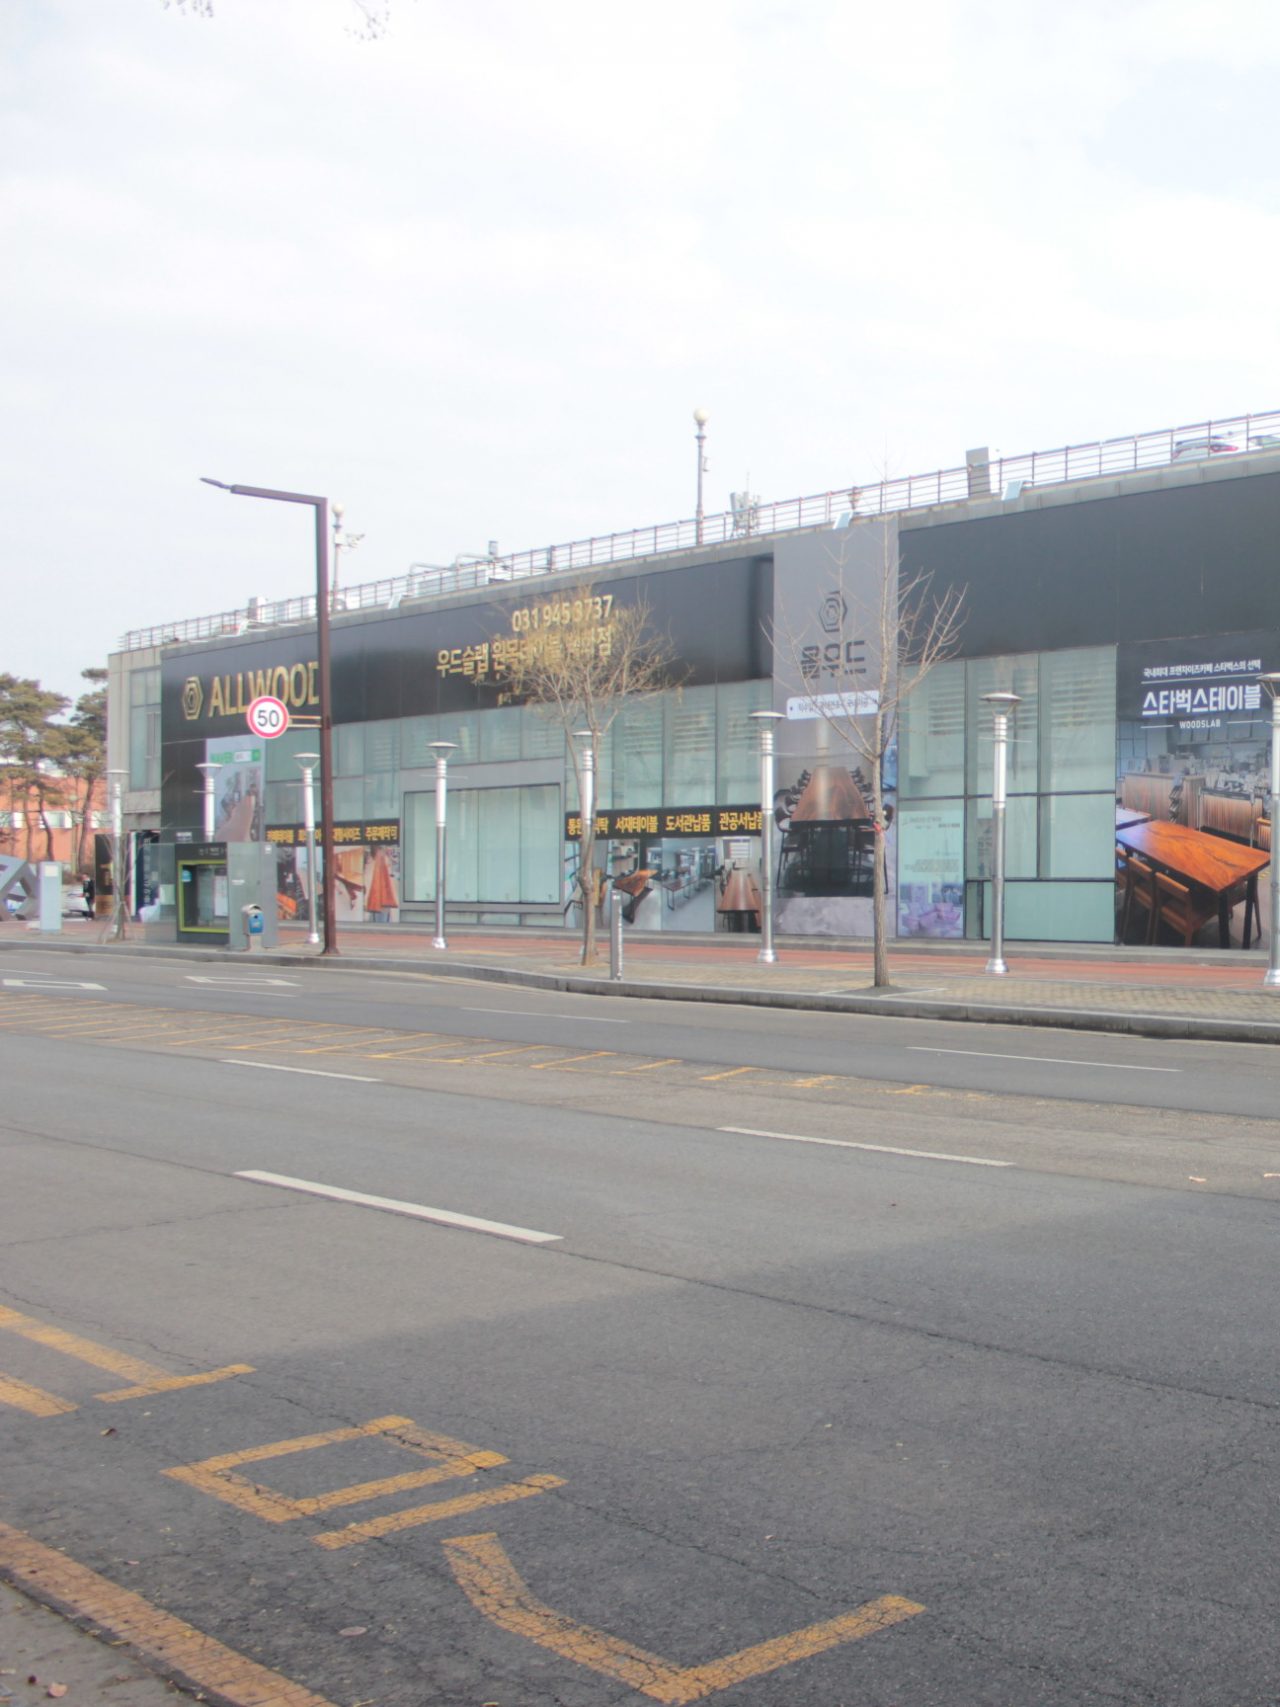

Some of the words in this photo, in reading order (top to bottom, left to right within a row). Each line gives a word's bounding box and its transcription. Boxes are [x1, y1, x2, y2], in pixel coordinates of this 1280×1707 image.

[436, 642, 489, 678] 우드슬랩
[1142, 684, 1262, 716] 스타벅스테이블
[256, 709, 281, 728] 50
[1179, 718, 1221, 730] WOODSLAB
